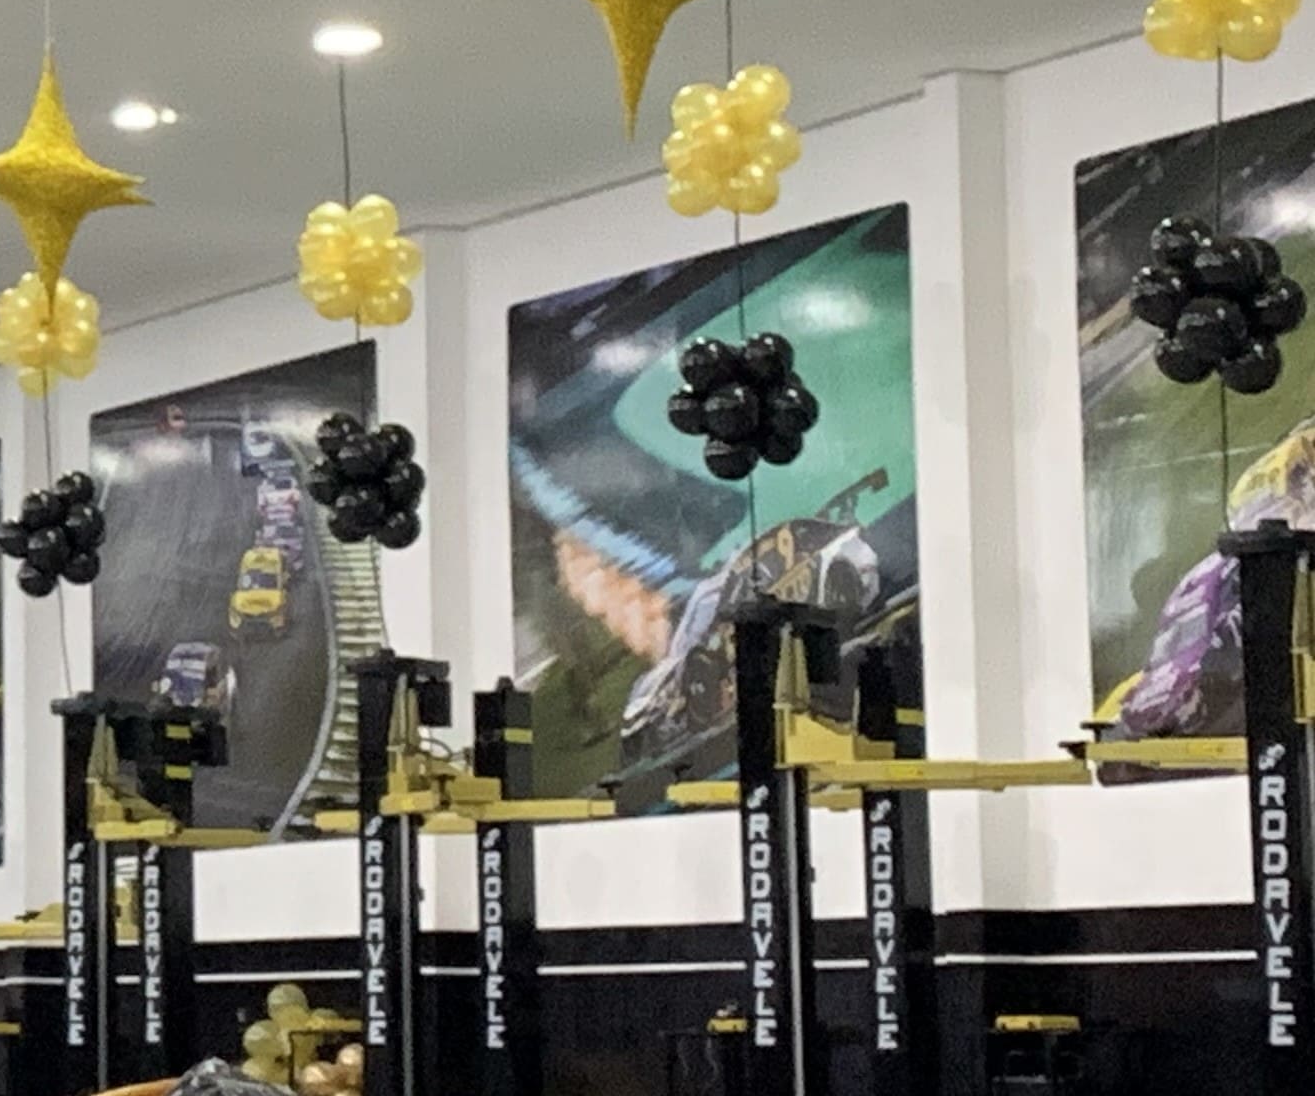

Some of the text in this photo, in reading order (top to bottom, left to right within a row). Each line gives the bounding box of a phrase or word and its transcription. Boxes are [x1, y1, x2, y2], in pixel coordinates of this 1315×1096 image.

[68, 863, 85, 1045] RODAVELE
[144, 865, 161, 1042] RODAVELE
[366, 840, 386, 1044] RODAVELE
[484, 851, 505, 1048] RODAVELE
[748, 813, 777, 1046] RODAVELE
[872, 826, 898, 1049] RODAVELE
[1259, 775, 1296, 1046] RODAVELE
